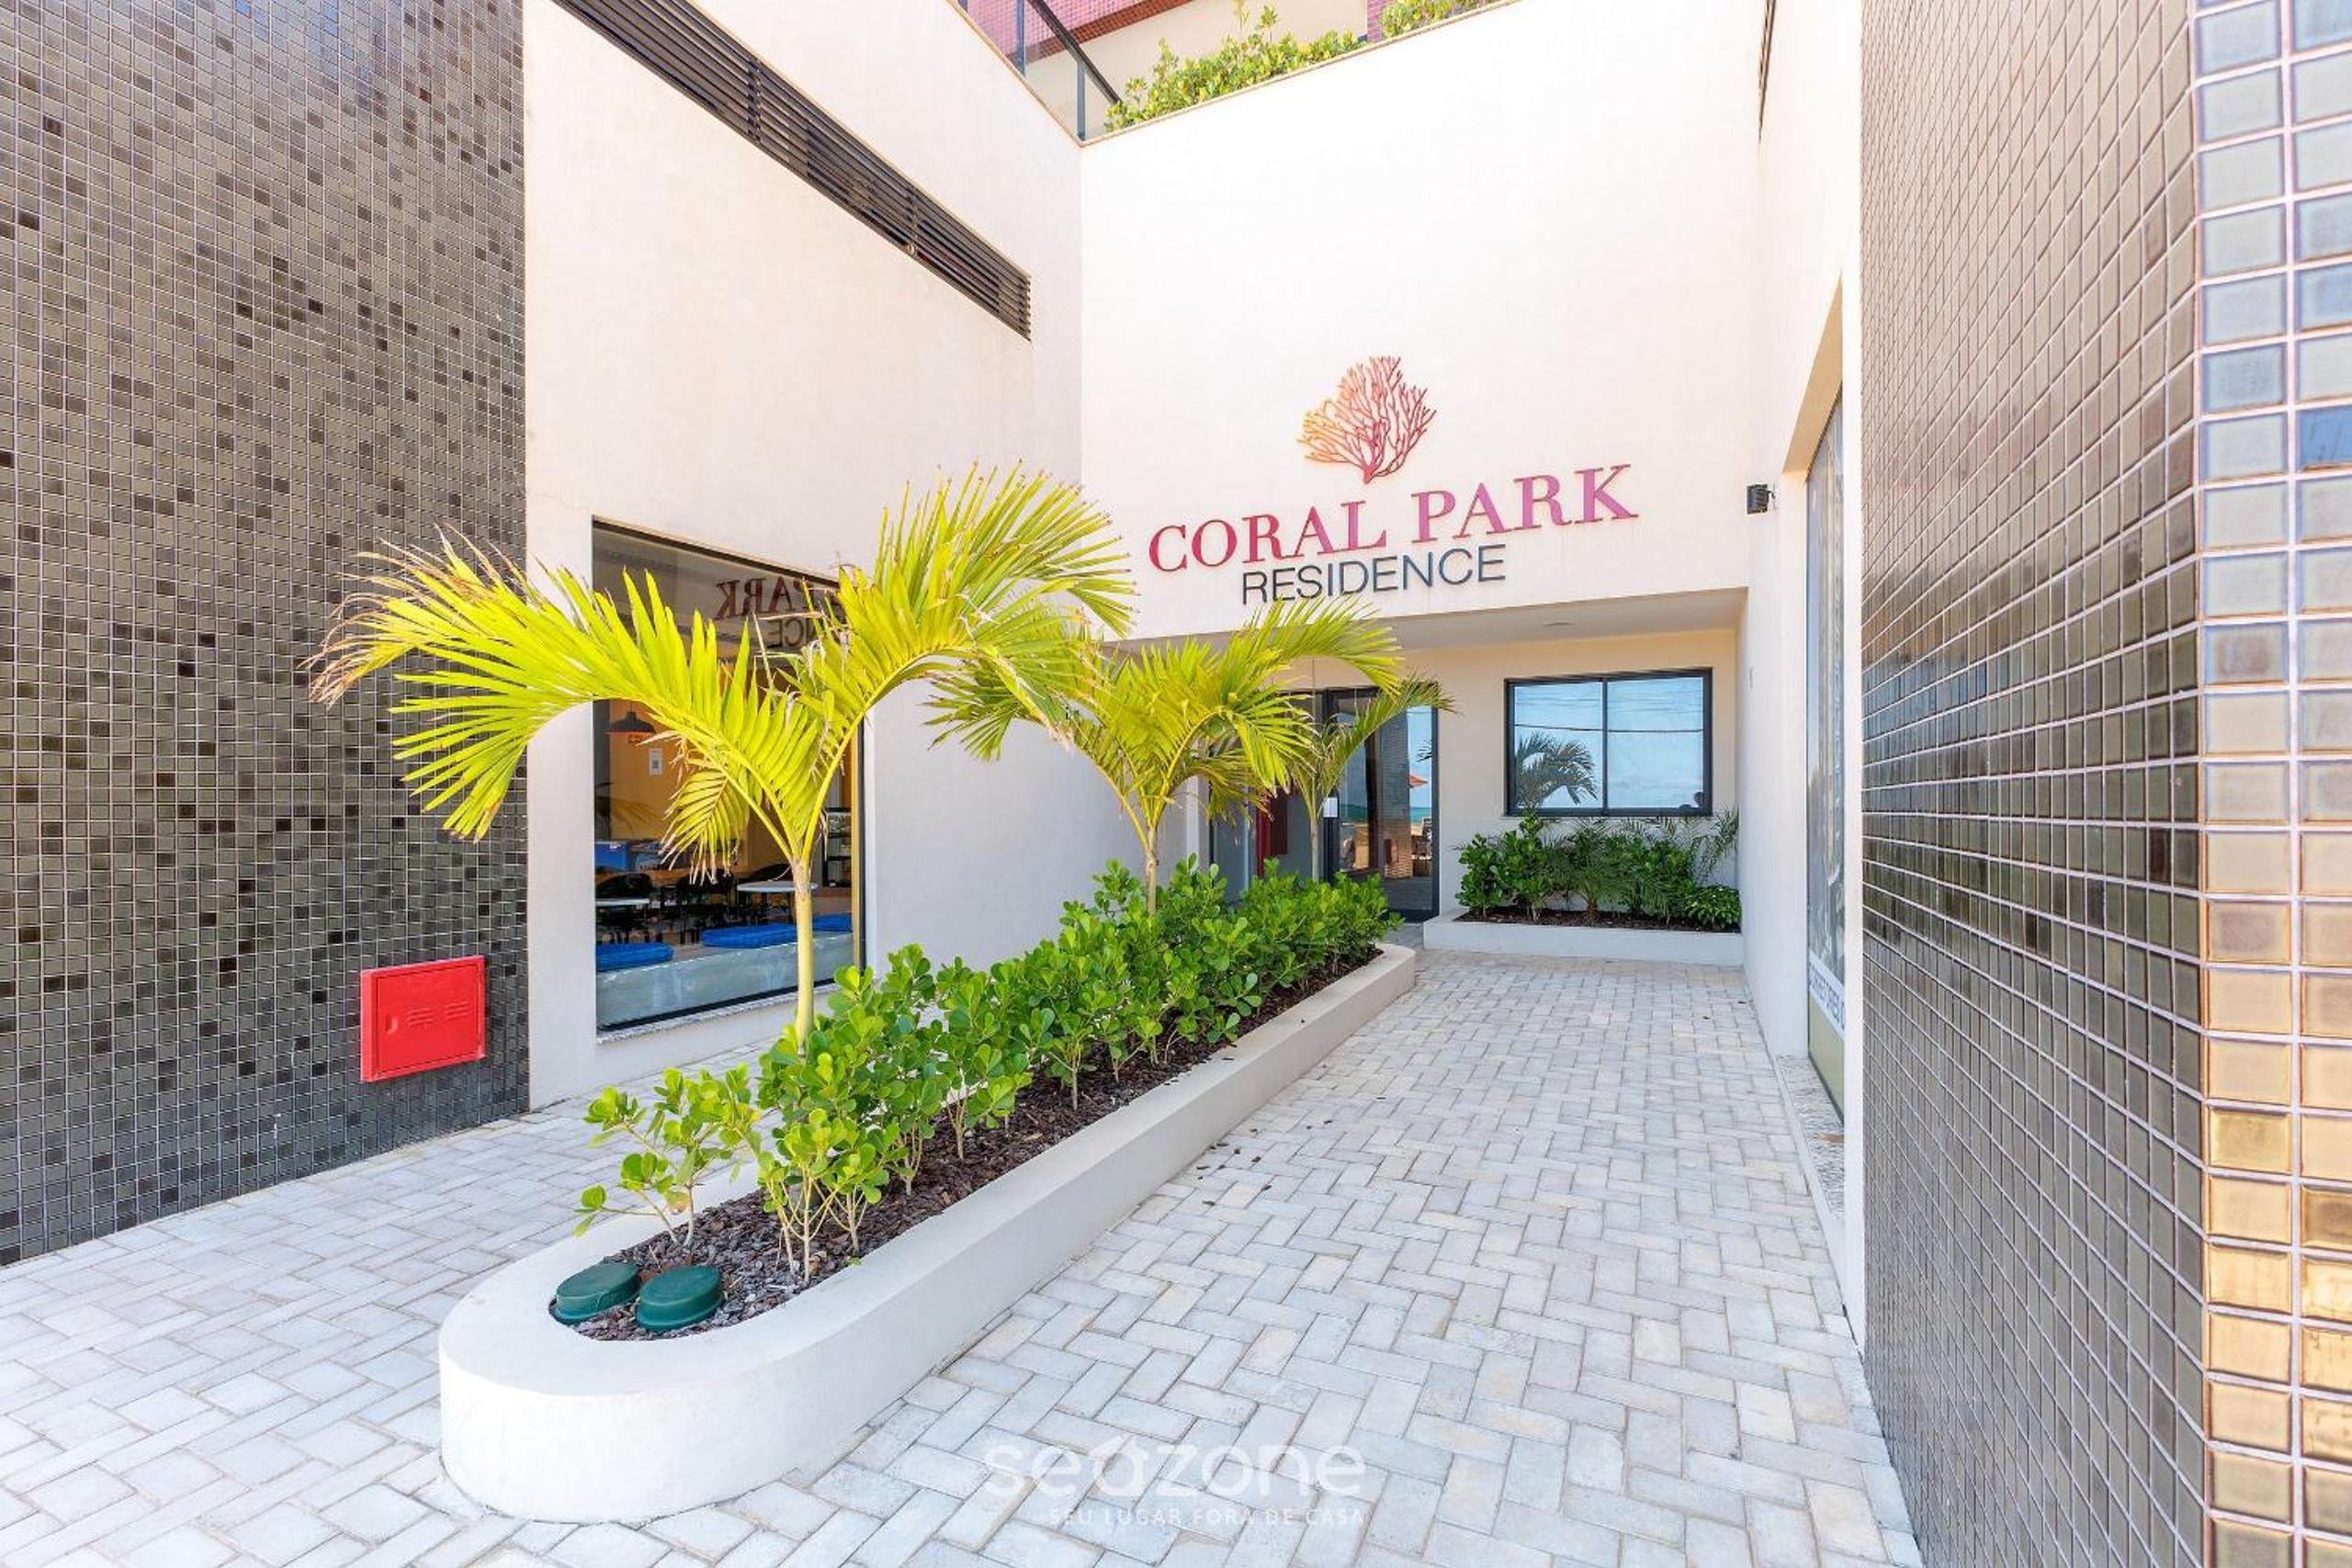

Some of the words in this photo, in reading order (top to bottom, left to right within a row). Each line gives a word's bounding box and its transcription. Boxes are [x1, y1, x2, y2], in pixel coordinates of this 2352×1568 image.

[1148, 499, 1387, 573] CORAL
[1410, 463, 1641, 544] PARK
[1241, 543, 1507, 605] RESIDENCE
